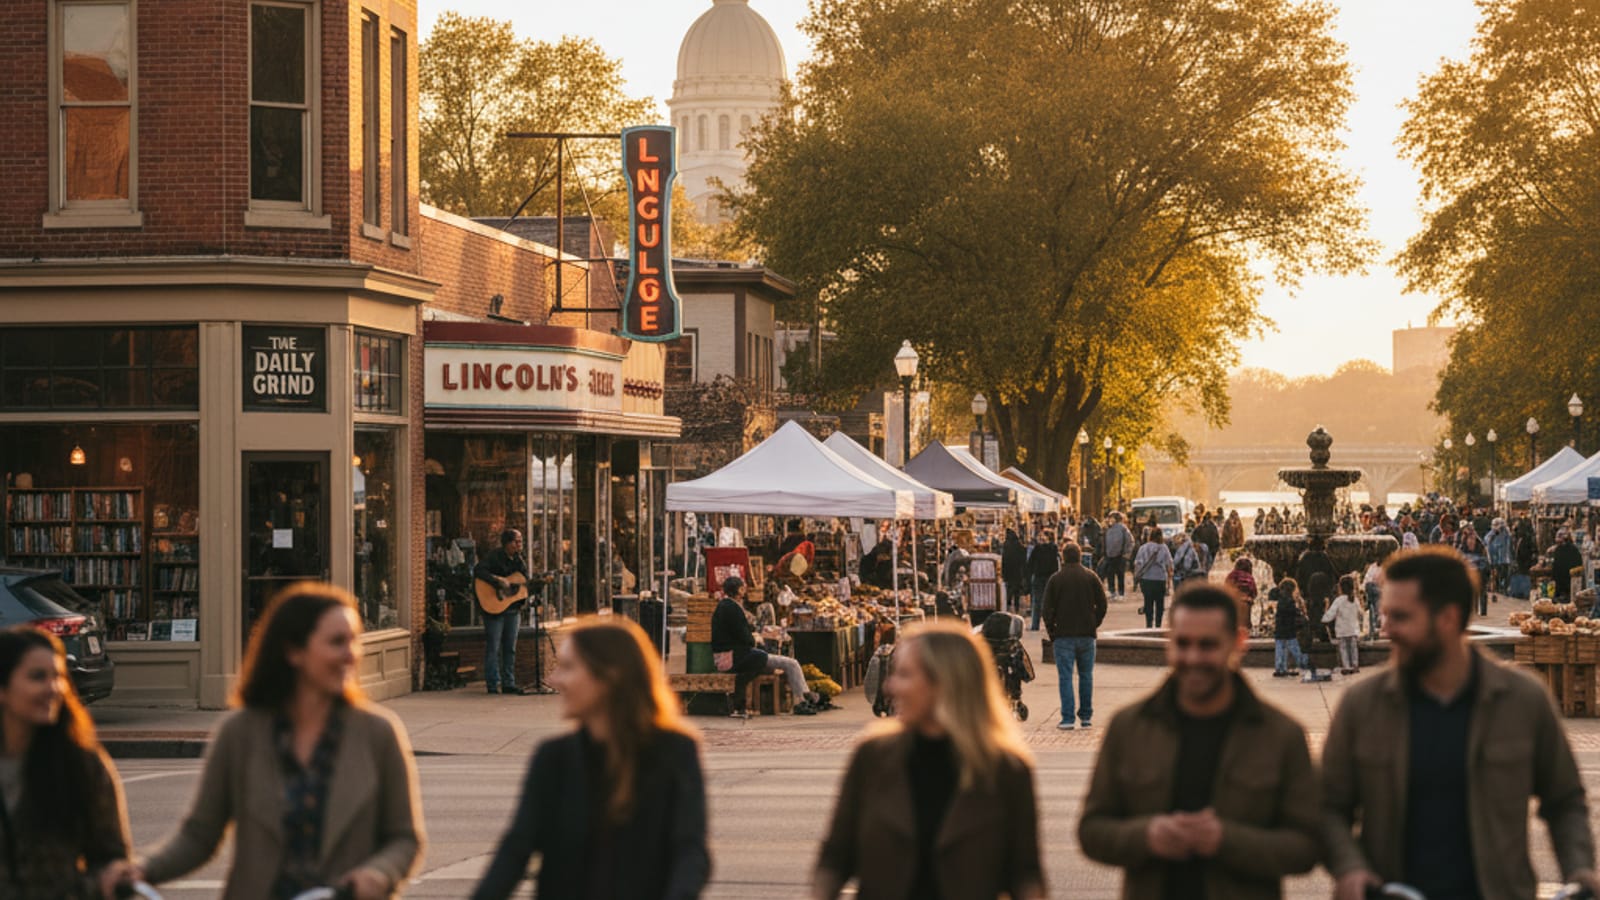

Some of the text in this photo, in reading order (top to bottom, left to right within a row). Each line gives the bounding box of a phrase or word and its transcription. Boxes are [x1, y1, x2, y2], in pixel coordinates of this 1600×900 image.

[255, 351, 315, 373] DAILY
[252, 374, 315, 395] GRIND
[442, 363, 579, 392] LINCOLN'S
